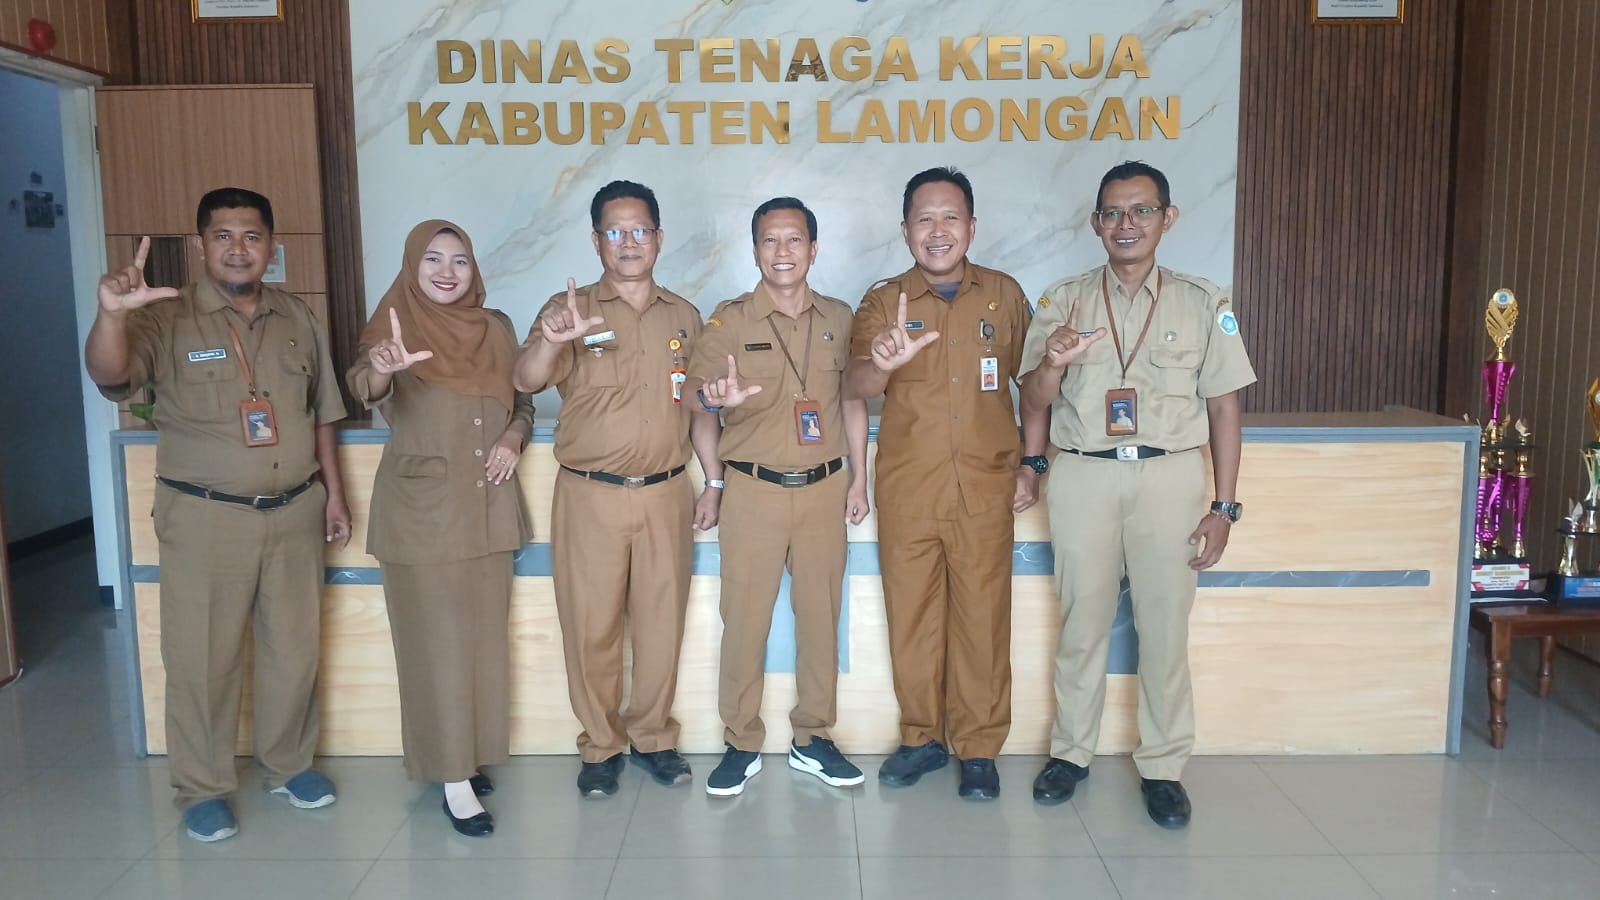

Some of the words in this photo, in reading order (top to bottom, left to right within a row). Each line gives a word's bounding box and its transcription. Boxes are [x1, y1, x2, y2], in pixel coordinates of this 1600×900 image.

[437, 38, 631, 85] DINAS
[655, 36, 919, 83] TENAGA
[938, 34, 1151, 81] KERJA
[408, 101, 790, 146] KABUPATEN
[817, 96, 1181, 143] LAMONGAN
